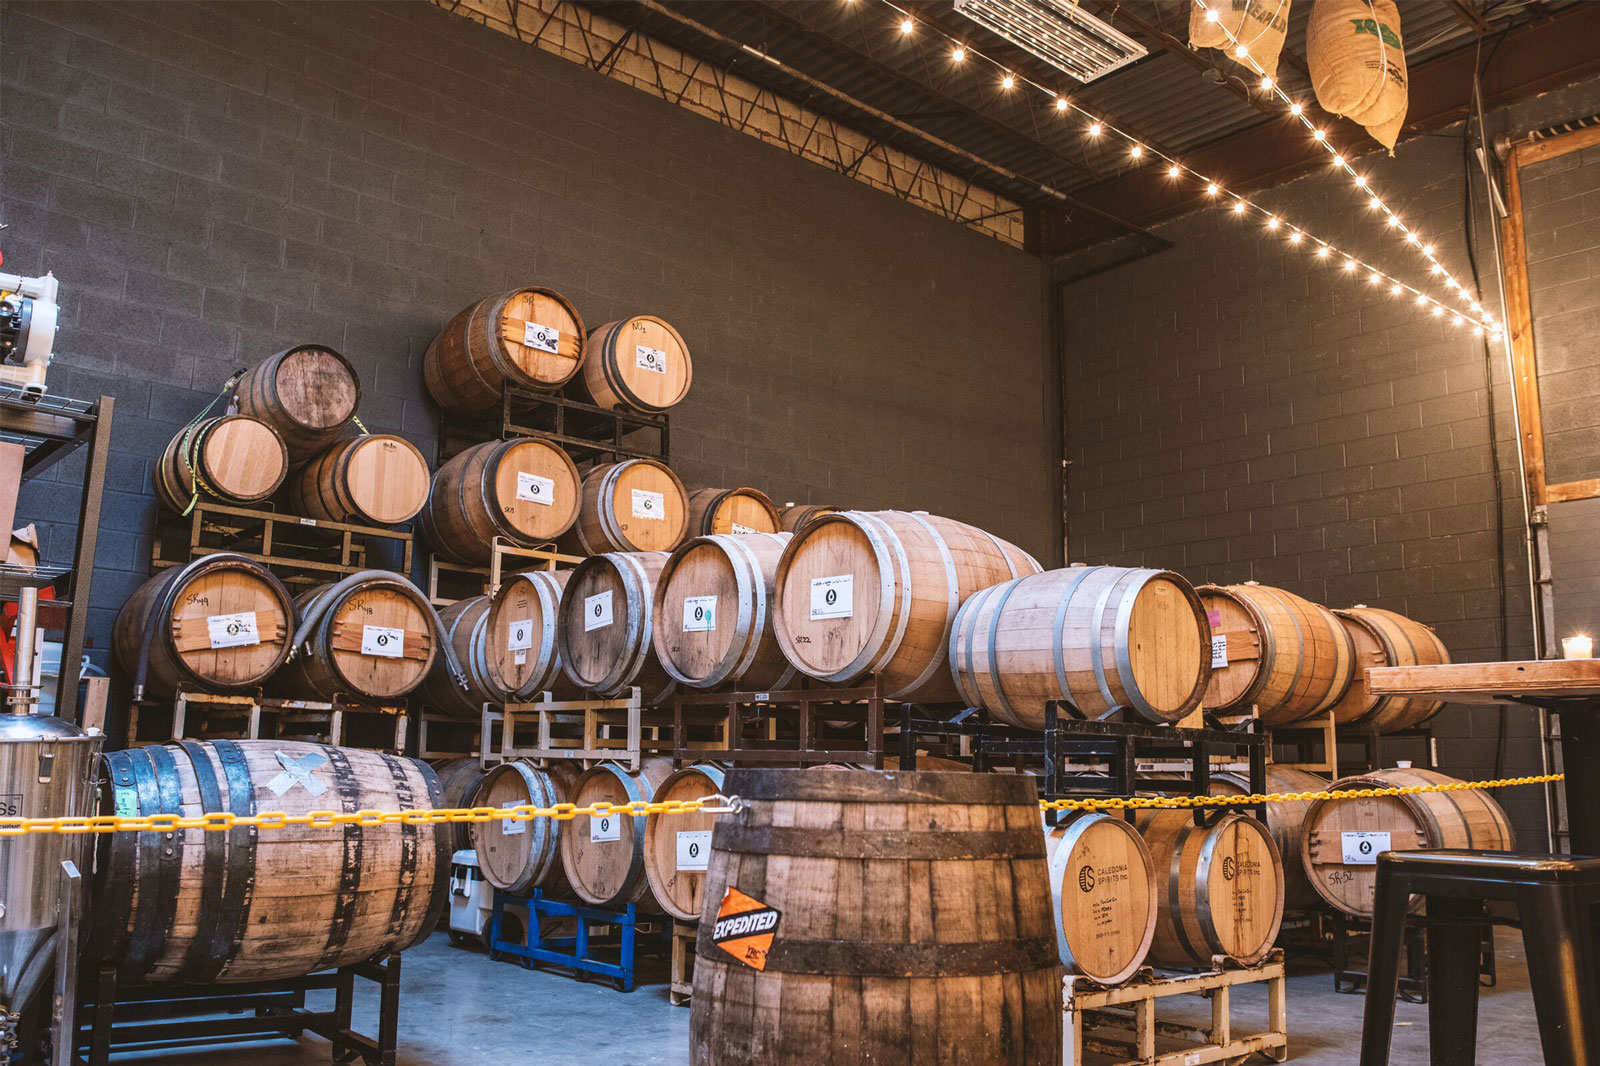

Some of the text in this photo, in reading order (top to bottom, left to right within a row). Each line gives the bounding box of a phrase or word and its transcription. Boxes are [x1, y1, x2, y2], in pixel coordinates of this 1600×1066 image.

[1097, 864, 1128, 876] CALEDONIA
[1098, 874, 1119, 885] SPIRITS
[712, 910, 778, 940] EXPEDITED
